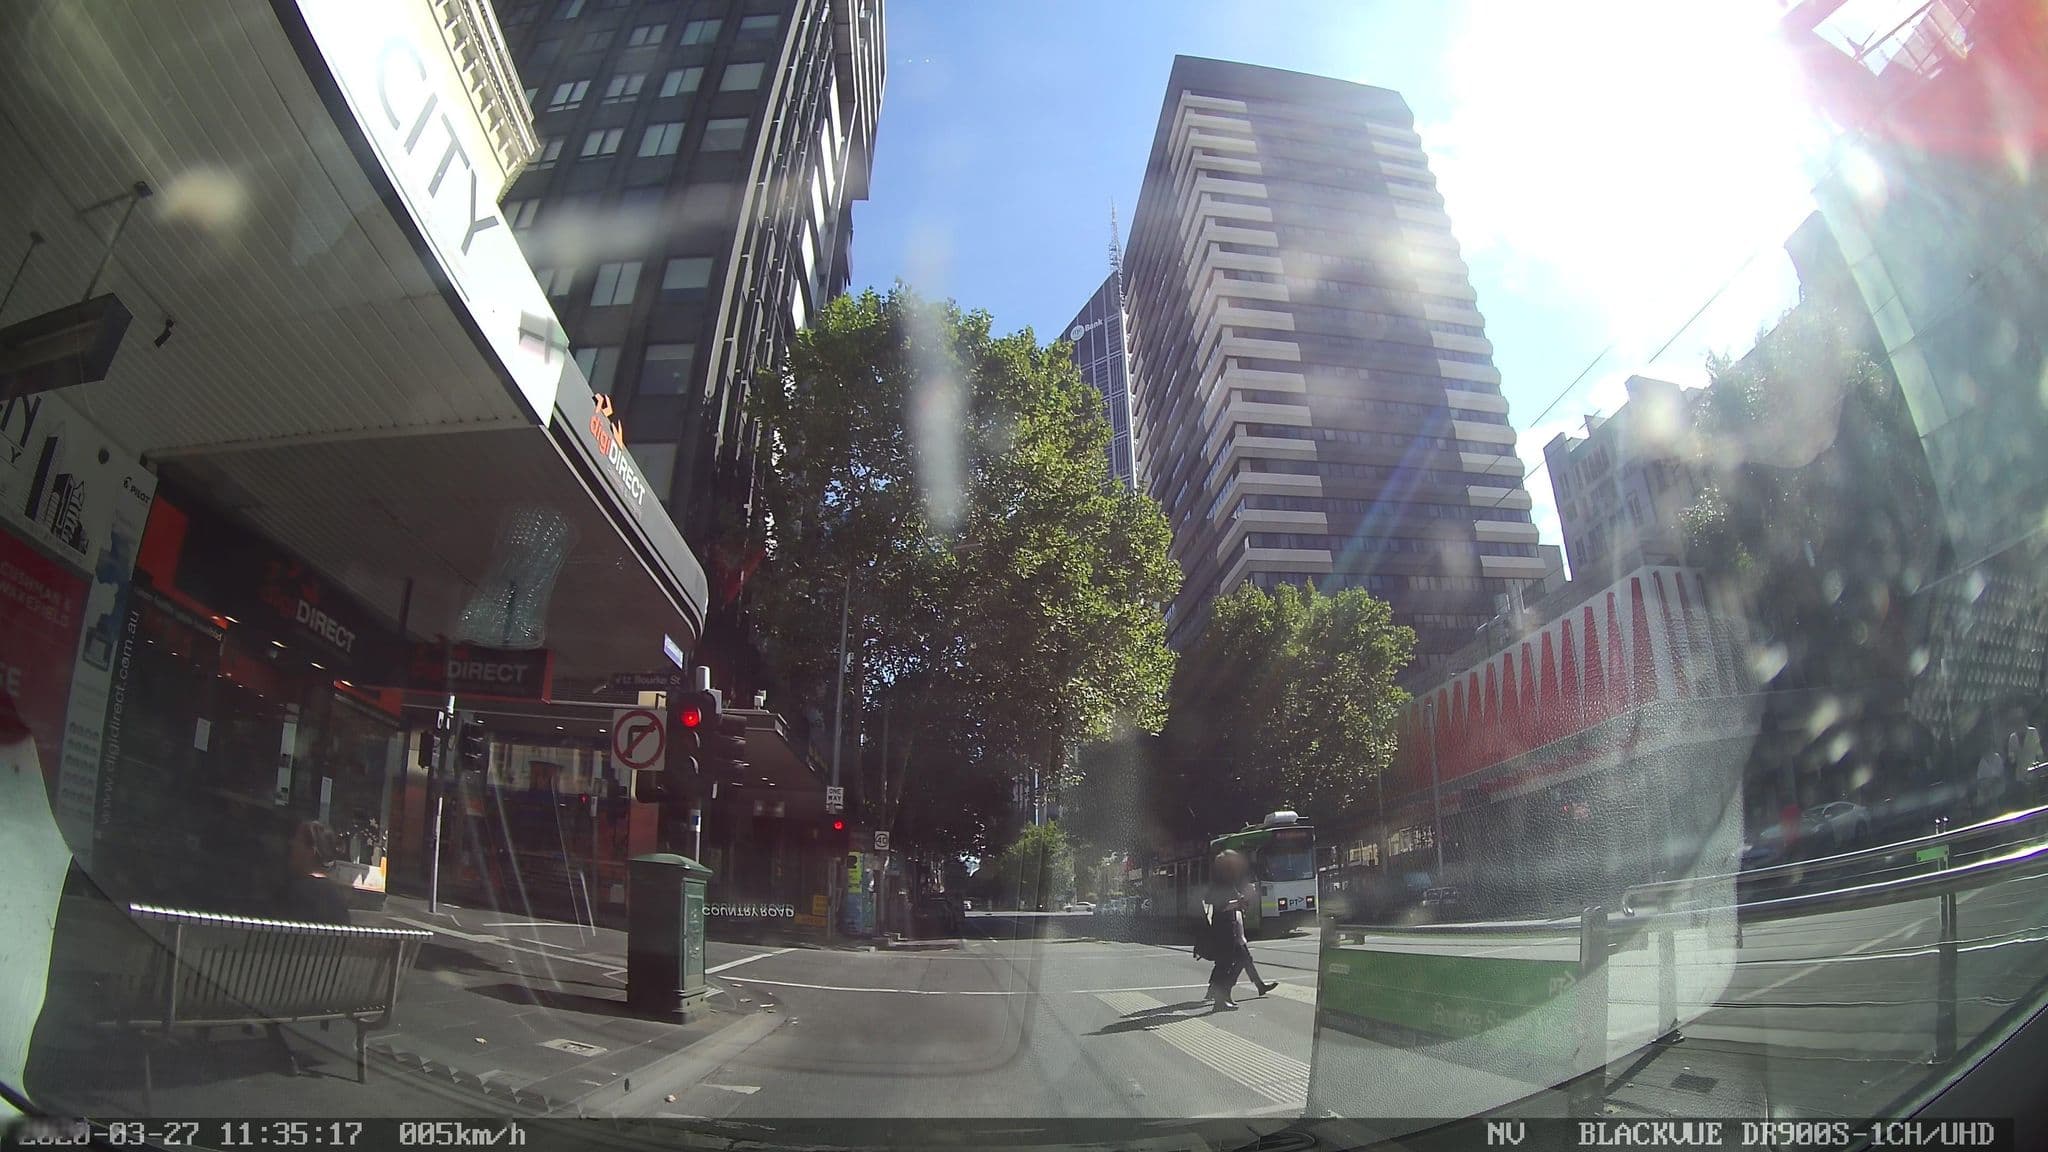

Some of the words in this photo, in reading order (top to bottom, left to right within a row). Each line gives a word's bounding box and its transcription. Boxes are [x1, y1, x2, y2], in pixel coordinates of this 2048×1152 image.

[376, 35, 500, 257] CITY
[589, 415, 646, 506] digiDIRECT
[101, 608, 141, 826] www.digidirect.com.au
